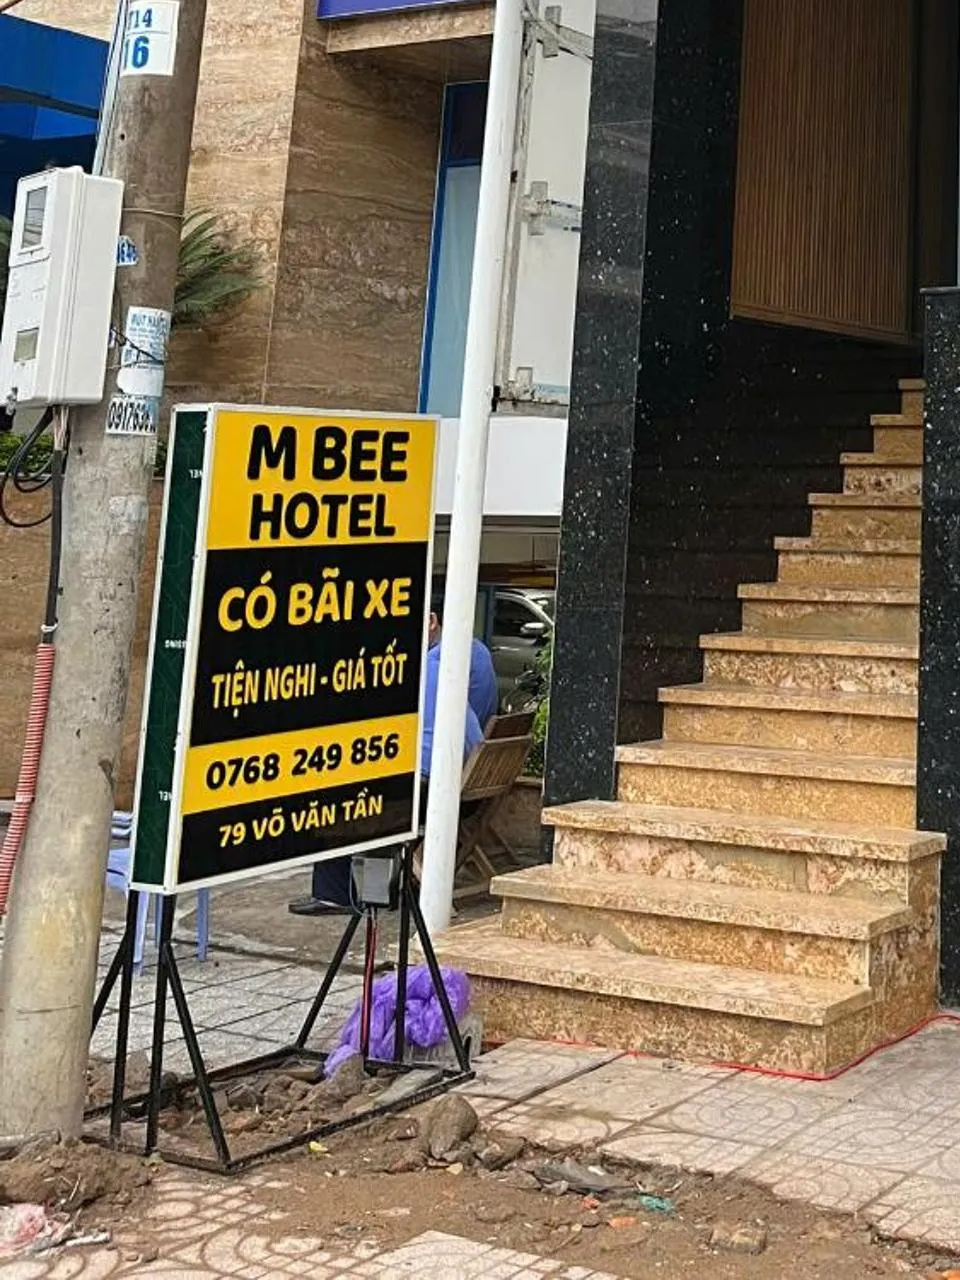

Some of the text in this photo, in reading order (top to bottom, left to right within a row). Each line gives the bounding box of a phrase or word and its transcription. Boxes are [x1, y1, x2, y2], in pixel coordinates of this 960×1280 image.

[247, 423, 411, 483] M BEE
[248, 491, 397, 541] HOTEL
[218, 567, 412, 632] CÓ BÃI XE
[211, 659, 260, 718] TIỆN
[264, 662, 317, 702] NGHI
[332, 647, 366, 693] GIÁ
[371, 637, 408, 687] TỐT
[206, 733, 400, 790] 0768 249 856
[219, 821, 246, 848] 79
[251, 807, 285, 841] VÕ
[291, 800, 336, 833] VĂN
